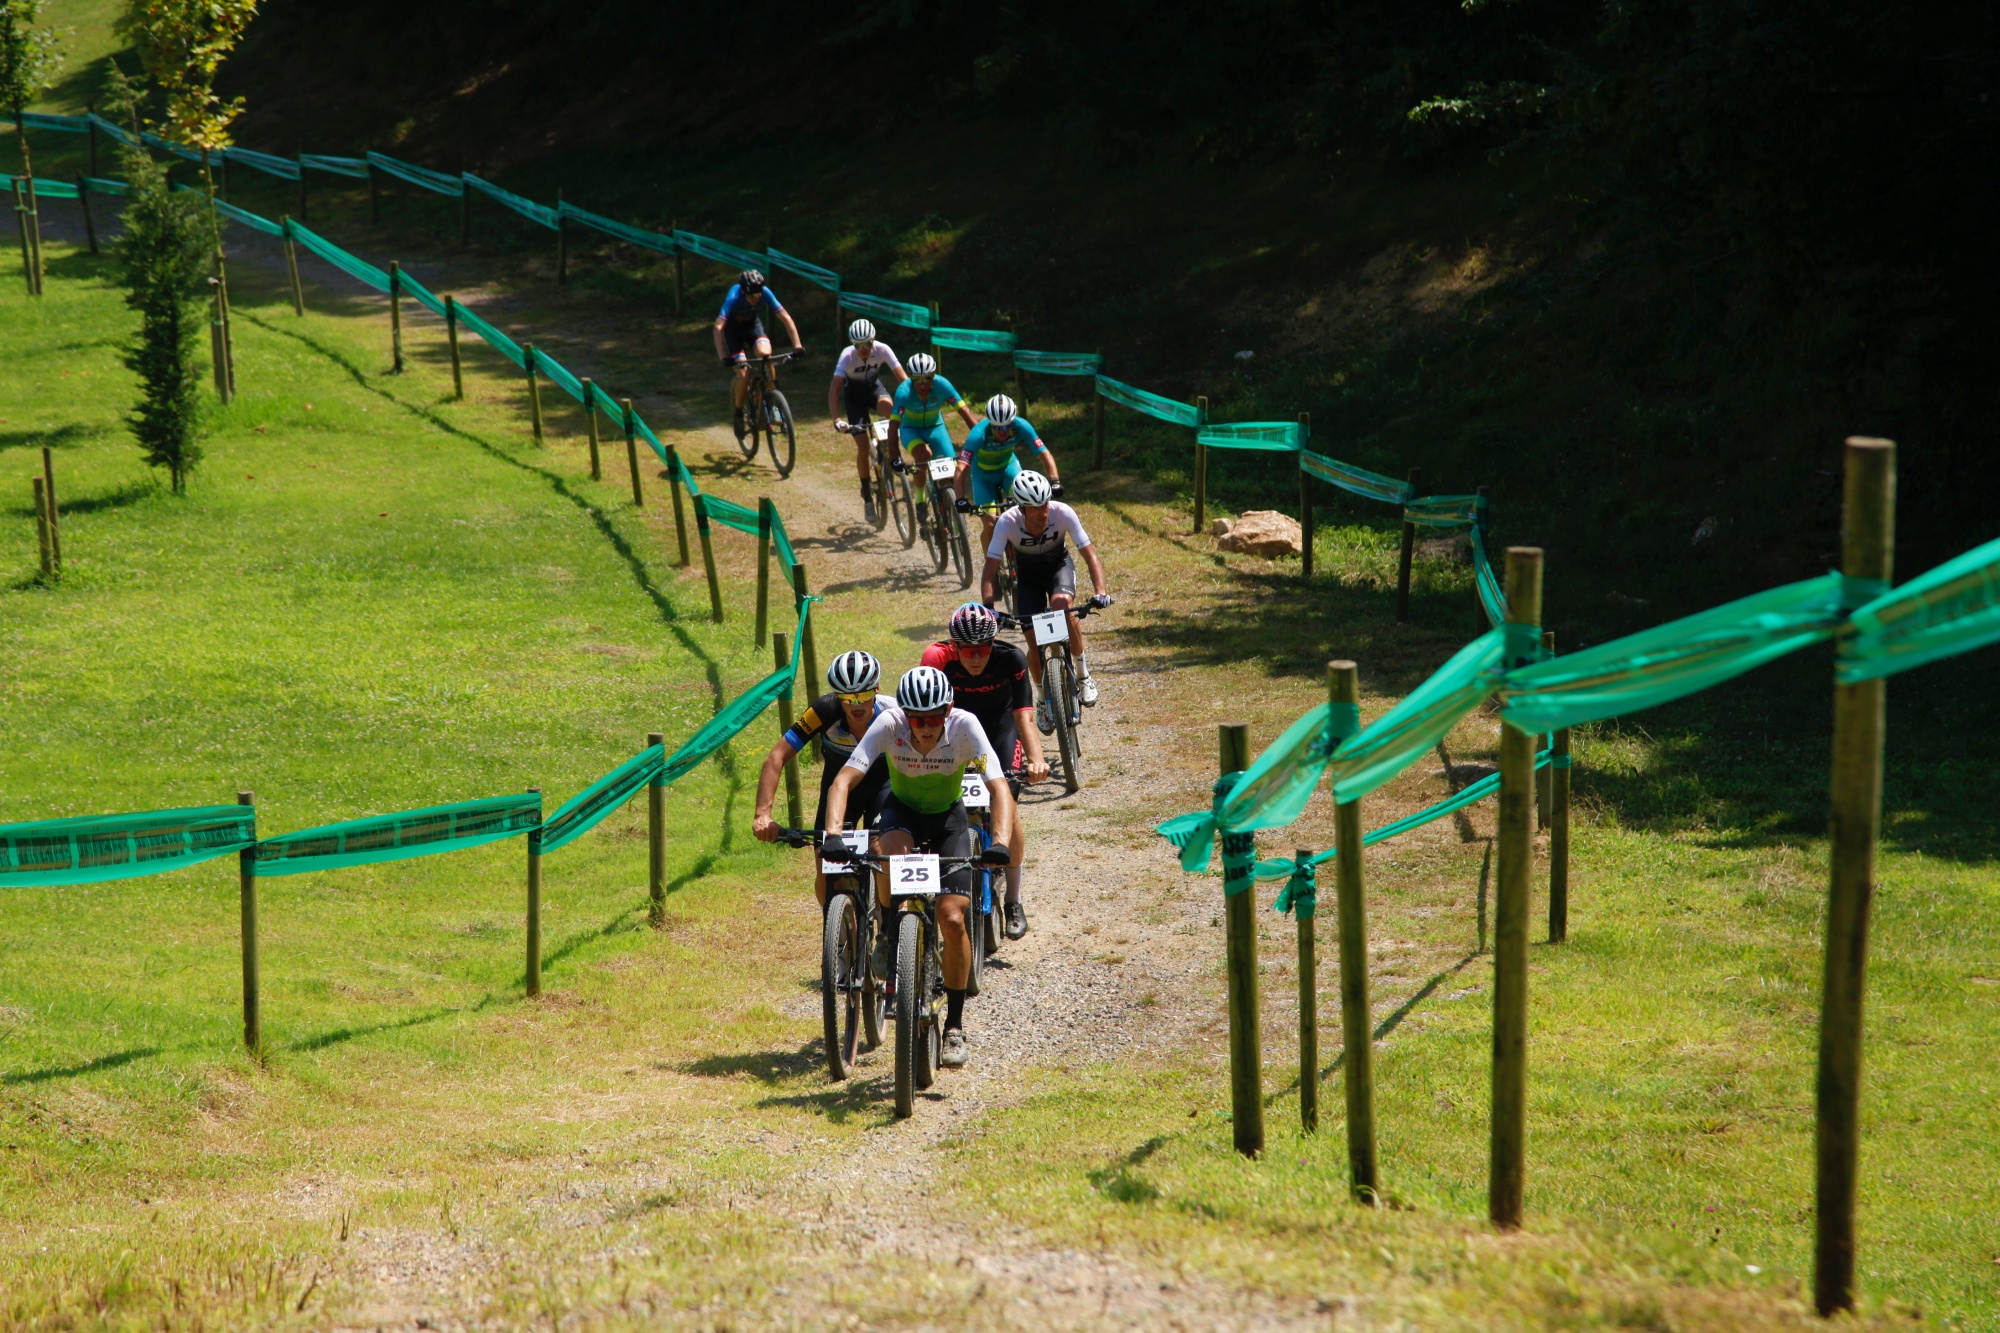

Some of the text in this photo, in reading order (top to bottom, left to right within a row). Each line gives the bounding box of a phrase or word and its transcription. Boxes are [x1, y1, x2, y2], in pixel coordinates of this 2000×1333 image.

[854, 363, 878, 373] BH
[936, 464, 949, 473] 16
[1020, 531, 1059, 547] BH
[1046, 622, 1055, 634] 1
[961, 784, 982, 797] 26
[901, 867, 929, 883] 25
